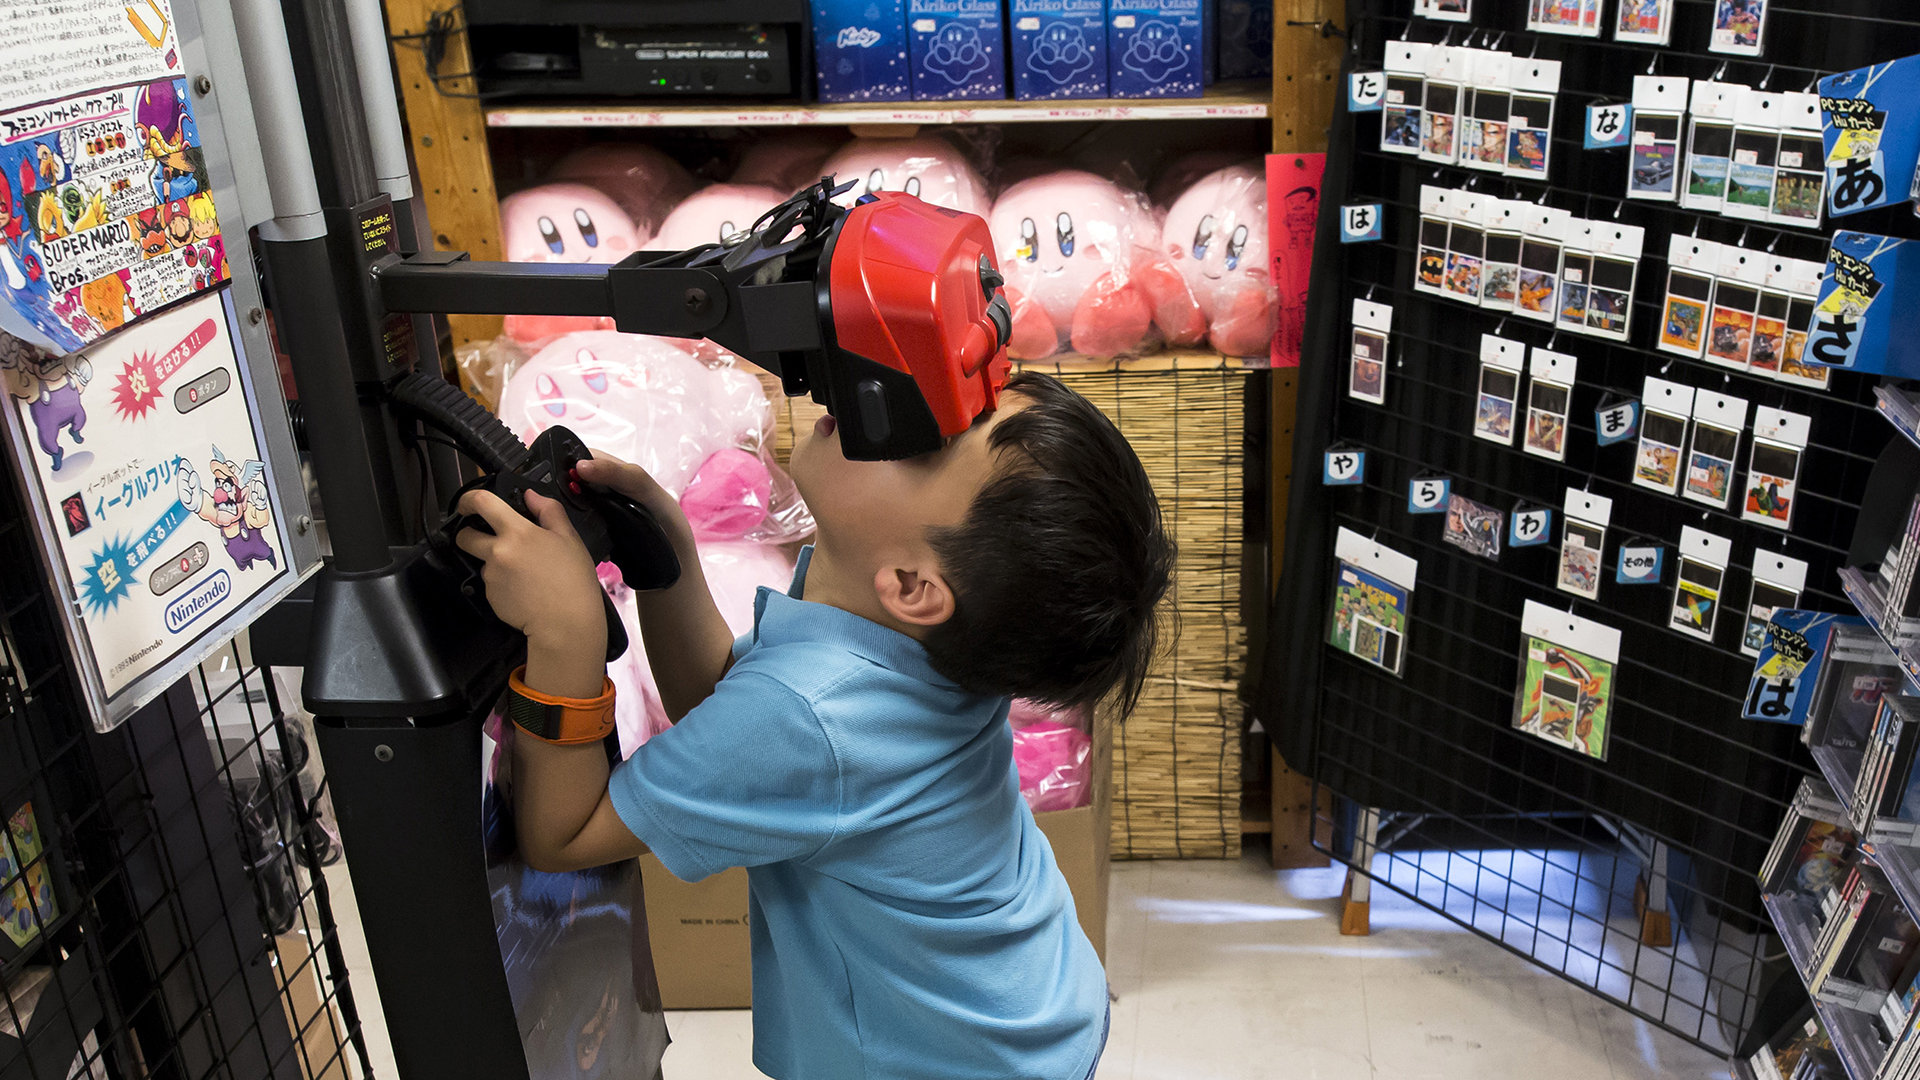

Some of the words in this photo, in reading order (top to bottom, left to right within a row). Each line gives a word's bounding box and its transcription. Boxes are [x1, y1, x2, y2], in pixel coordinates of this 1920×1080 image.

[1358, 75, 1377, 98] た
[1596, 108, 1619, 134] な
[1833, 158, 1884, 209] あ
[1350, 208, 1369, 229] は
[42, 233, 90, 267] SUPER
[89, 220, 130, 252] MARIO
[49, 267, 89, 293] Bros.
[1812, 315, 1857, 365] さ
[128, 367, 150, 402] 炎
[1605, 410, 1625, 432] ま
[1334, 455, 1353, 475] や
[94, 453, 182, 521] イーグルワリオ
[1420, 482, 1437, 503] ら
[1520, 514, 1540, 535] わ
[1624, 556, 1655, 568] その他
[98, 558, 121, 594] 空
[171, 581, 227, 626] Nintendo
[1748, 676, 1795, 717] は
